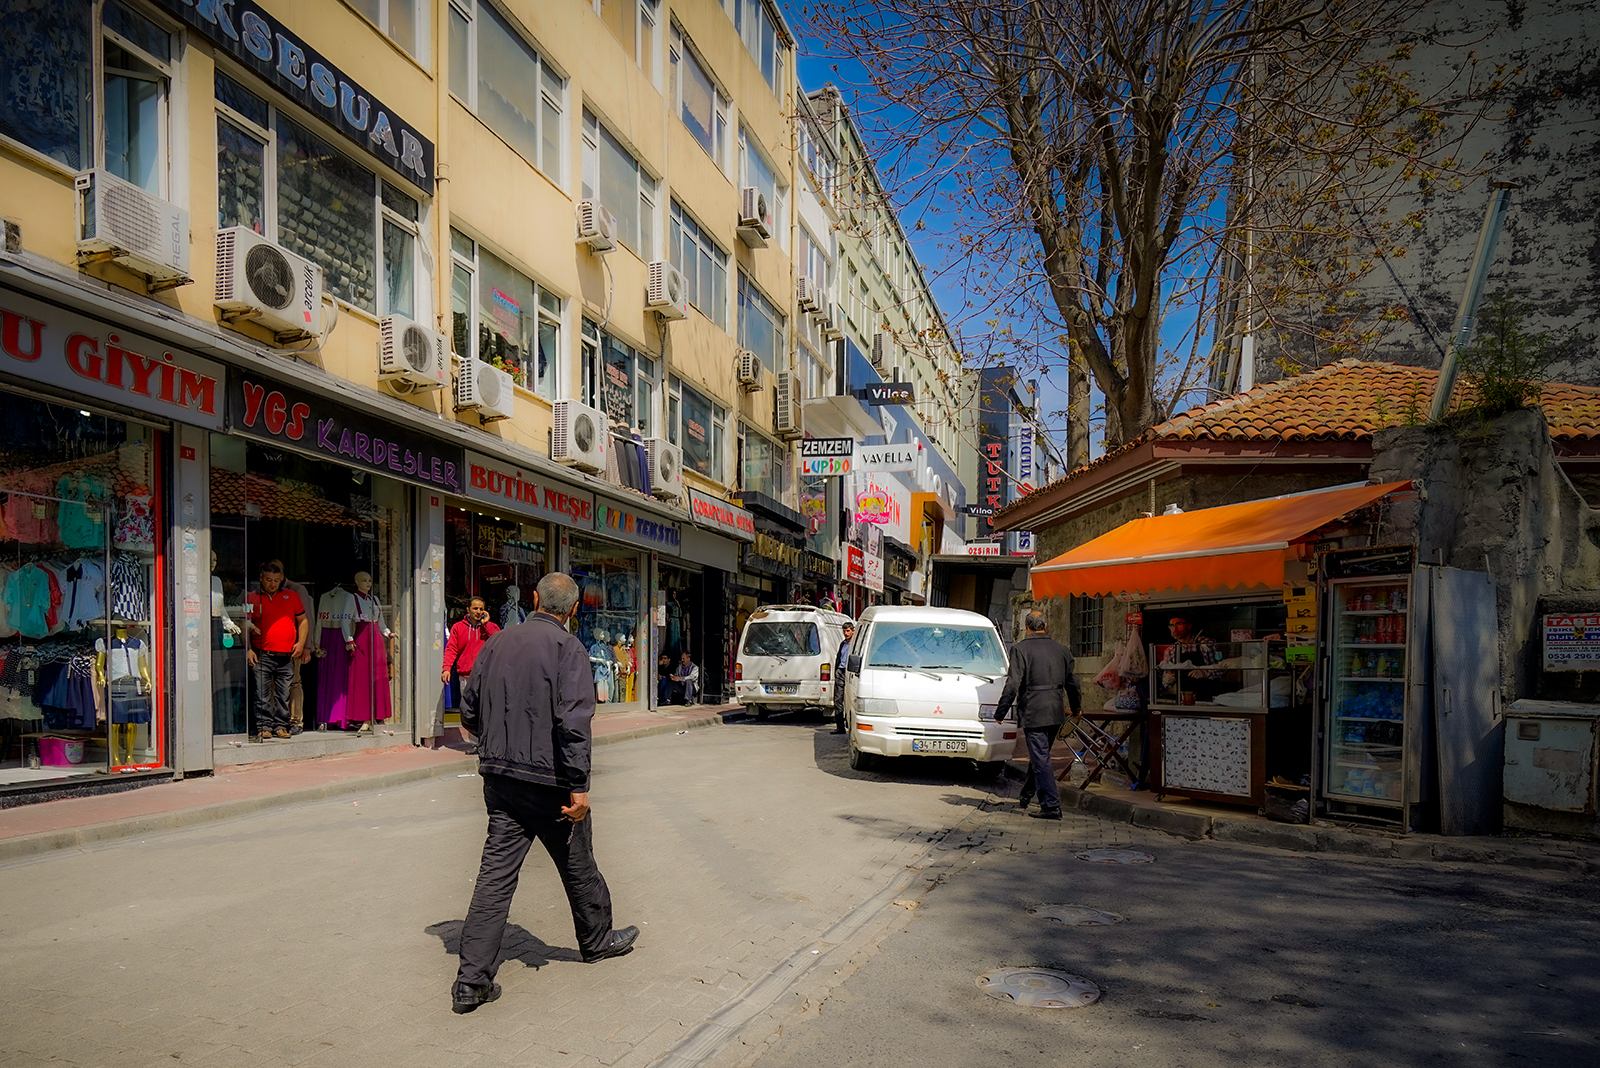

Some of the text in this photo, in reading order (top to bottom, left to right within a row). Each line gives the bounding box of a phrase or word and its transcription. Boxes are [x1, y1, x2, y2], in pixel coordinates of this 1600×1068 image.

[182, 0, 427, 178] KSESUAR
[172, 212, 181, 269] REGAL
[303, 264, 315, 312] arçelik
[436, 337, 445, 372] arçelik
[64, 331, 218, 417] GİYİM
[242, 380, 312, 441] YGS
[803, 439, 852, 456] ZEMZEM
[803, 457, 851, 474] LUPİDO
[862, 450, 913, 466] VAVELLA
[1020, 427, 1032, 479] YILDIZI
[469, 461, 593, 524] BUTİK NEŞE
[970, 506, 993, 515] Vilna
[597, 505, 680, 546] ŞITIR TEKSTİL
[693, 498, 755, 534] ÇORAPÇILAR SİTESİ
[319, 612, 330, 620] YGS
[919, 740, 967, 751] 34 FT 6079
